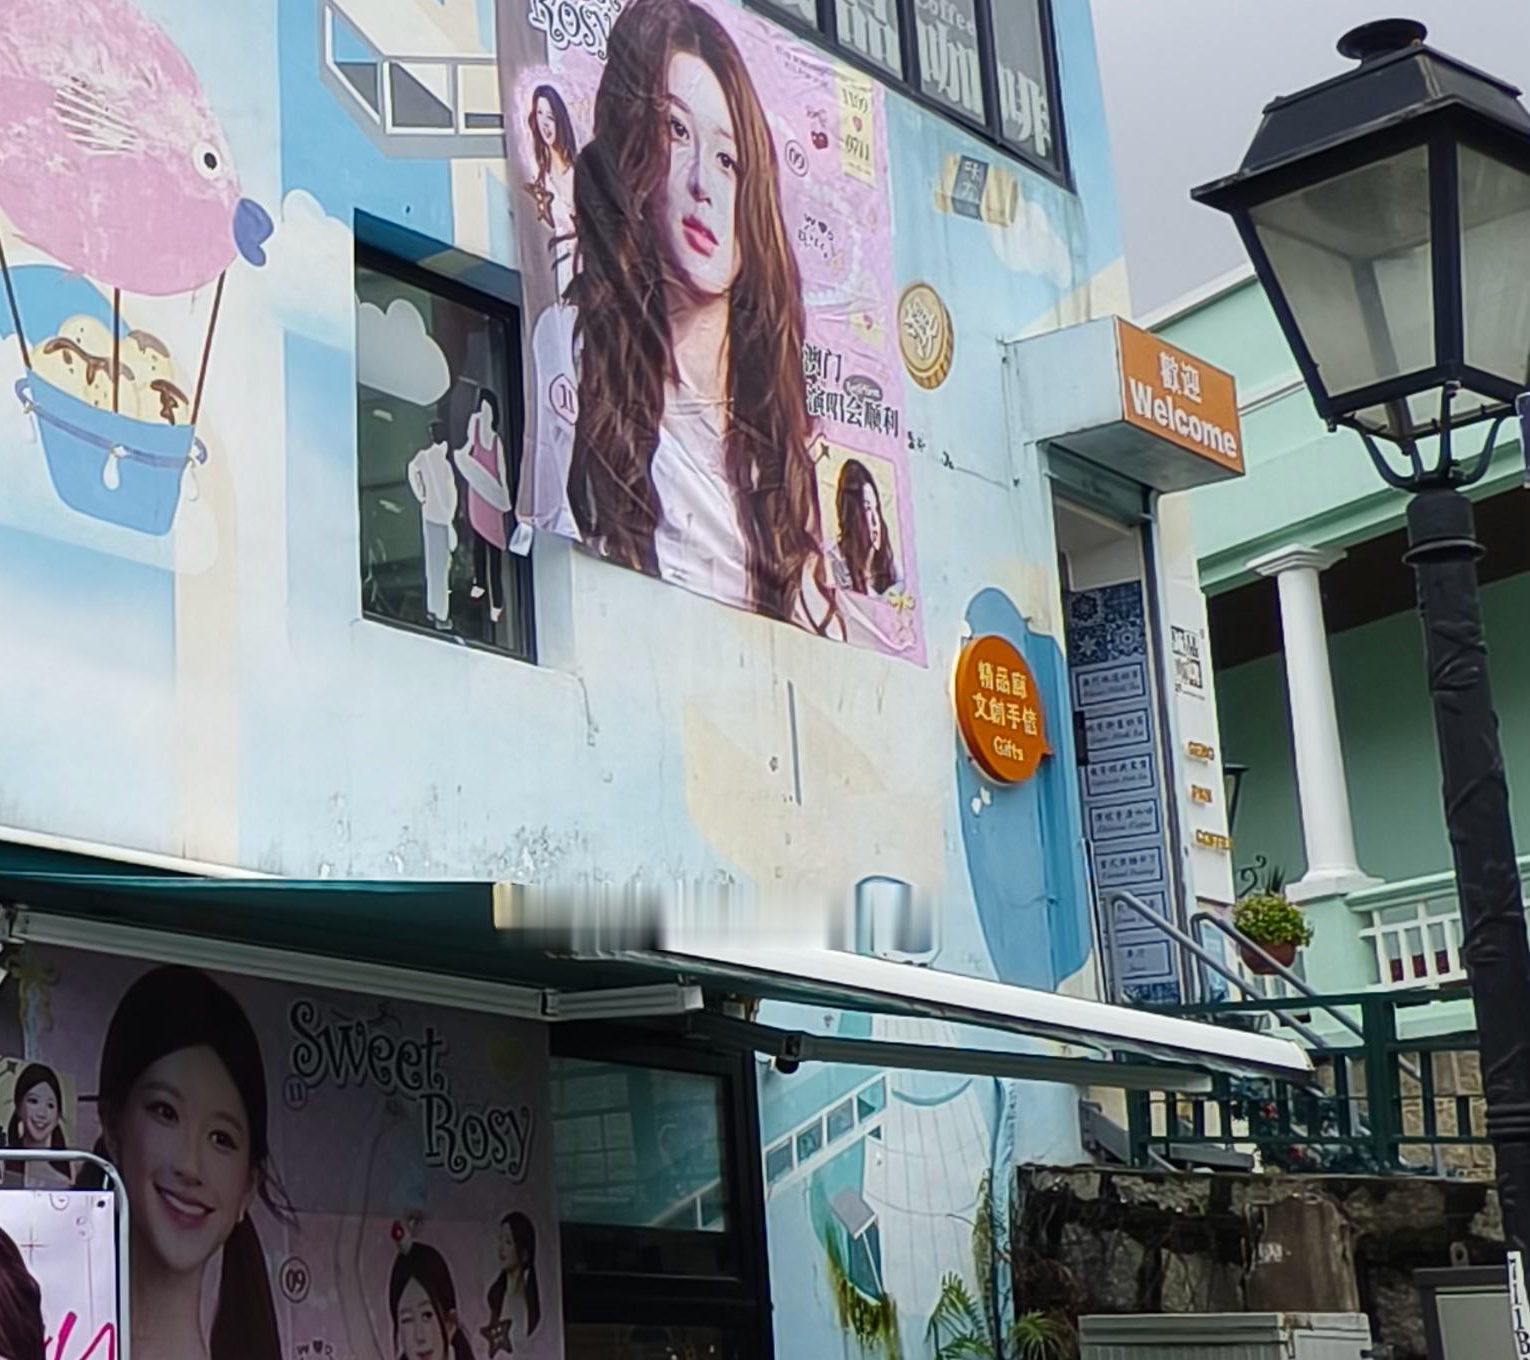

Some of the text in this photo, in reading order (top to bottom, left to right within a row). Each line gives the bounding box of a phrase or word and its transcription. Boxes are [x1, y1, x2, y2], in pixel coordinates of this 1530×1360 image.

[1127, 375, 1238, 459] Welcome
[993, 735, 1024, 761] Gifts
[289, 1000, 447, 1093] Sweet
[419, 1092, 534, 1177] Rosy
[285, 1268, 307, 1294] 09
